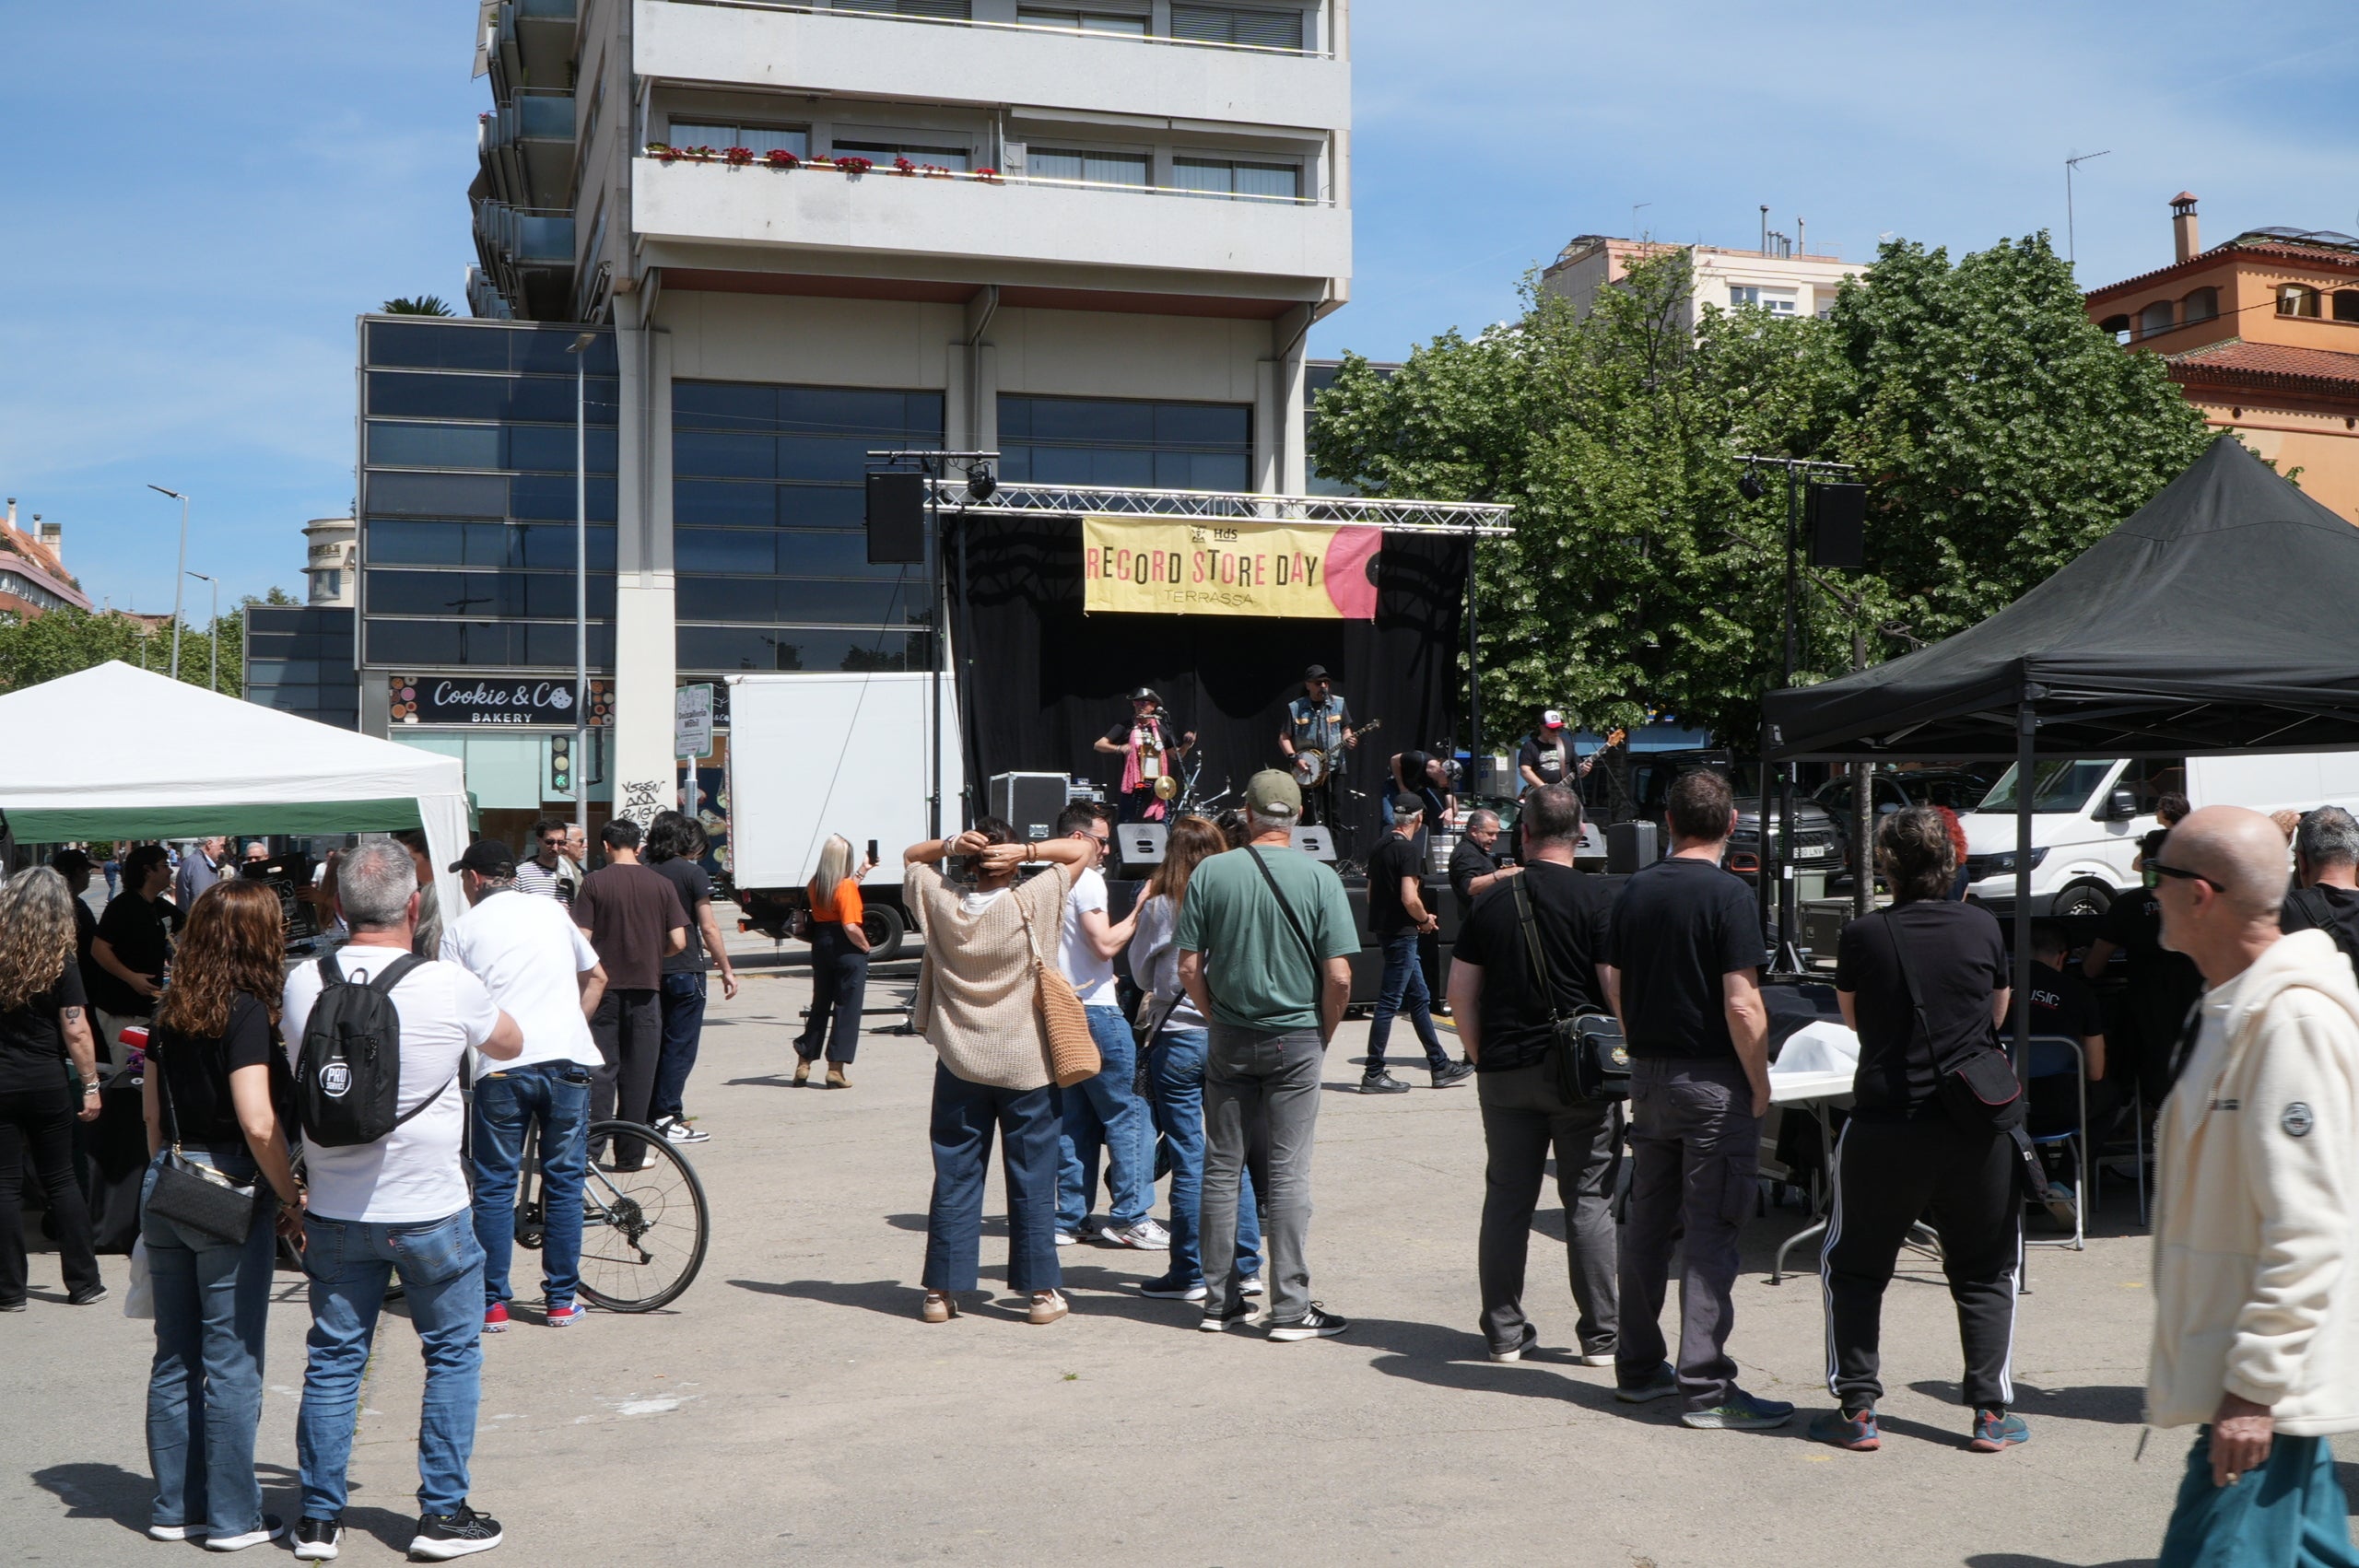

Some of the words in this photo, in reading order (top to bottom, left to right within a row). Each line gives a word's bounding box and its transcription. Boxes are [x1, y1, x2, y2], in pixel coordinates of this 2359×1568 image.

[1214, 528, 1238, 540] HdS
[1086, 546, 1181, 585] RECORD
[1192, 549, 1266, 587] STORE
[1276, 552, 1318, 587] DAY
[1164, 589, 1254, 606] TERRASSA
[434, 680, 509, 706] Cookie
[511, 685, 529, 705] &
[472, 713, 532, 723] BAKERY
[327, 1068, 346, 1082] PRO
